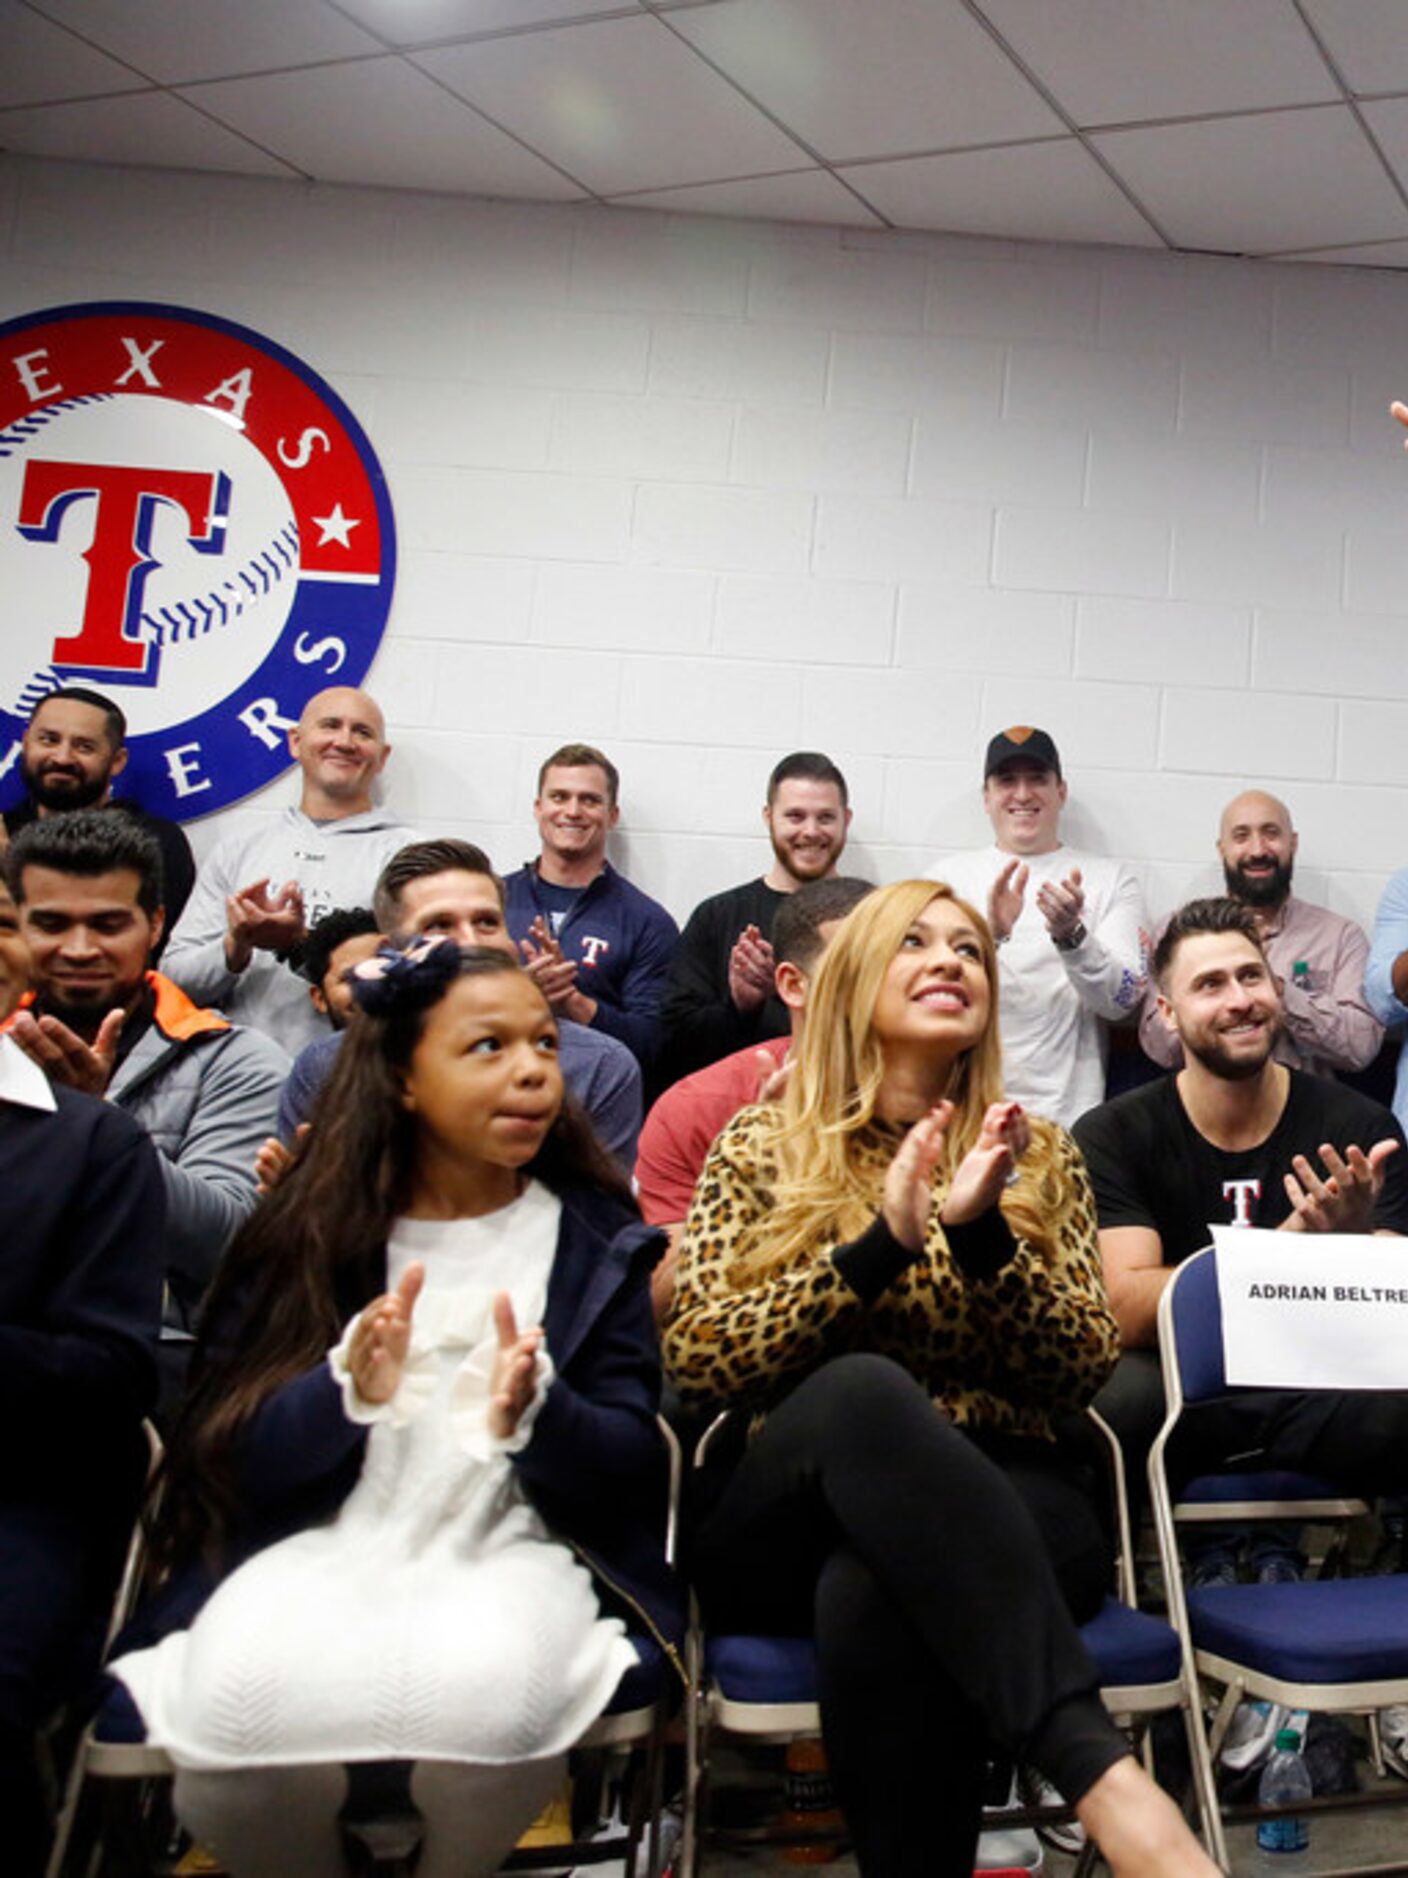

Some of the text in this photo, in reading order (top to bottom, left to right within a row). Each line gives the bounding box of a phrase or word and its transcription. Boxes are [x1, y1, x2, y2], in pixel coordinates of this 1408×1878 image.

[12, 337, 331, 469] EXAS
[16, 459, 232, 688] T
[582, 935, 609, 969] T
[1223, 1179, 1264, 1228] T
[1249, 1283, 1327, 1301] ADRIAN
